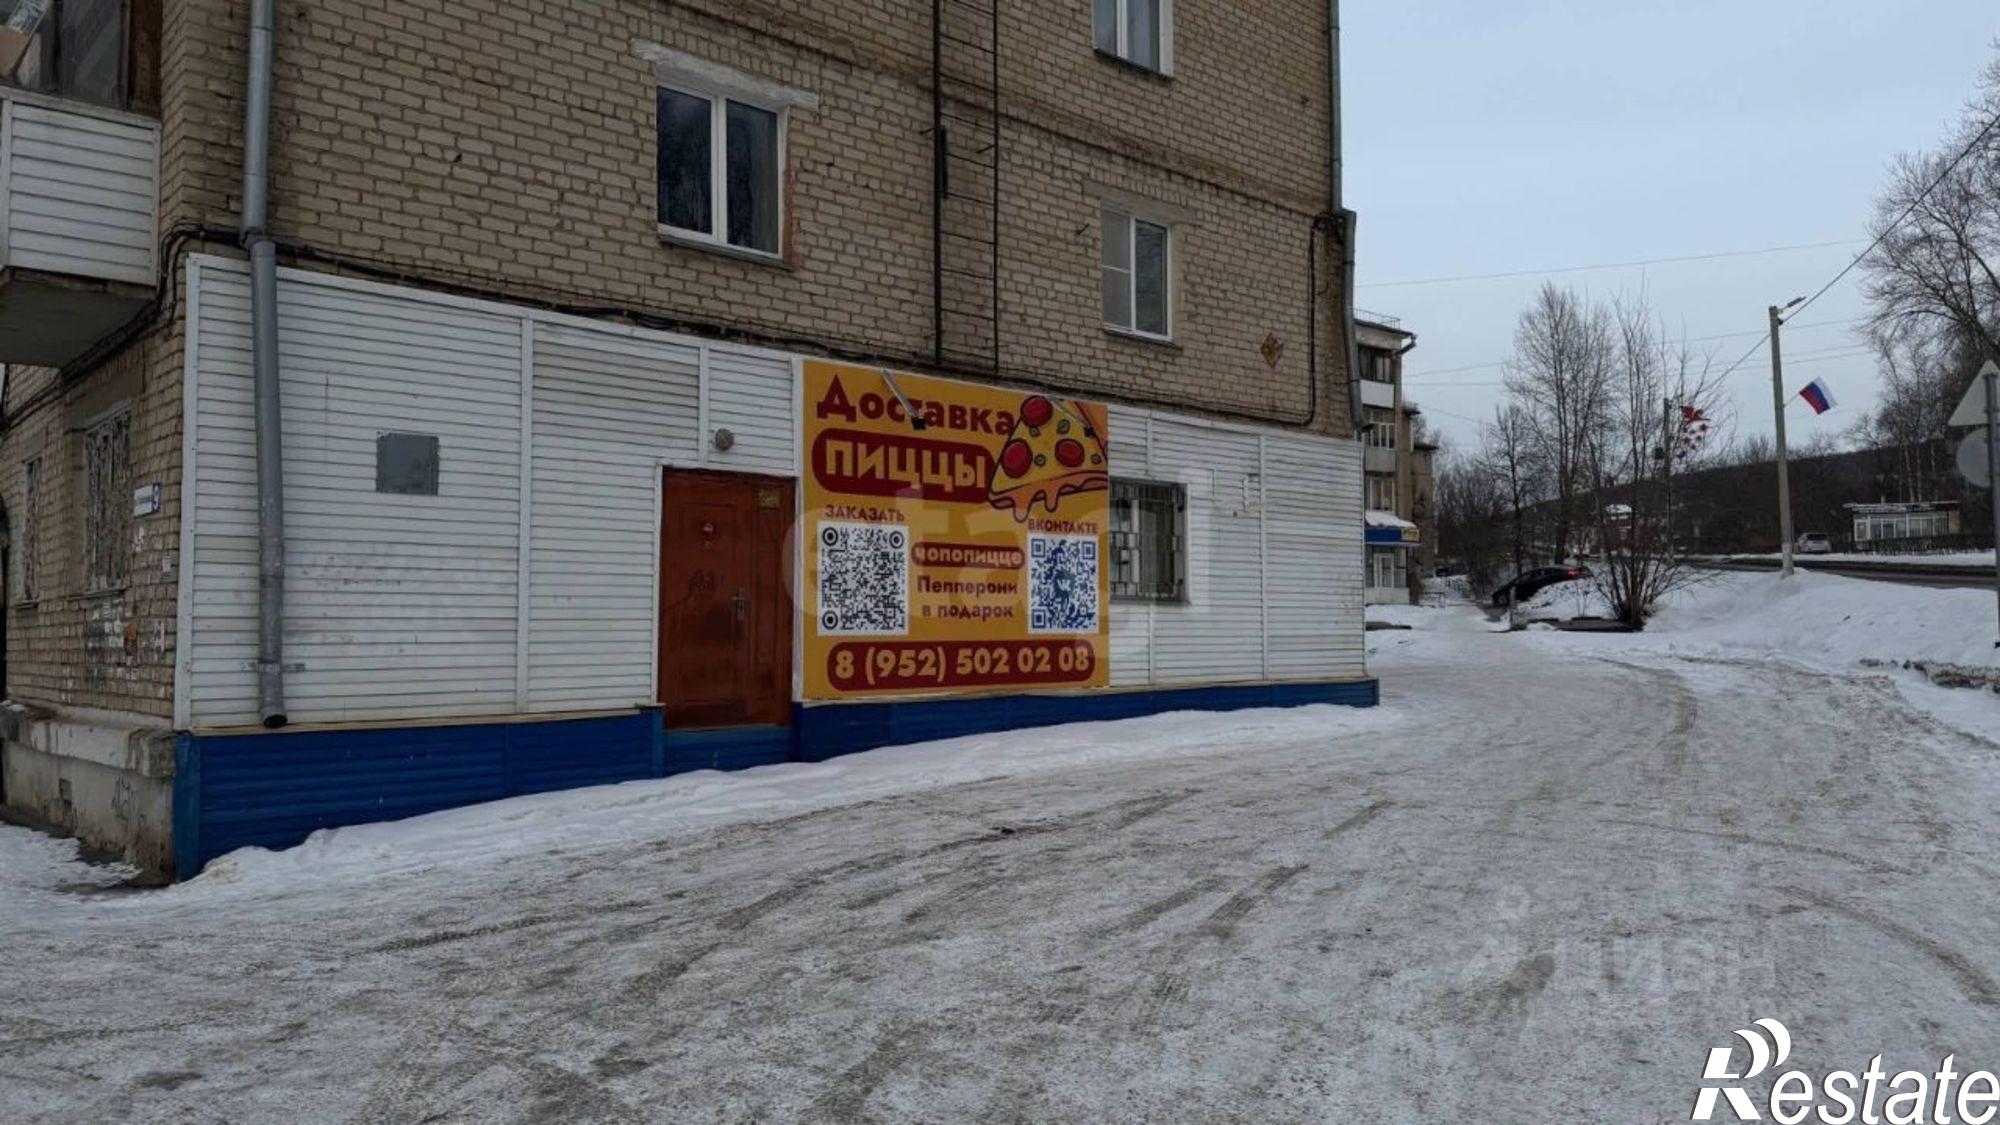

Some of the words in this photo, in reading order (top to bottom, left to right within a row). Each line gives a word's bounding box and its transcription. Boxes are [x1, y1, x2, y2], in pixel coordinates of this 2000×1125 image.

[825, 504, 906, 521] ЗАКАЗАТЬ
[1028, 519, 1098, 534] ВКОНТАКТЕ
[917, 575, 1018, 598] Пепперони
[922, 604, 932, 617] в
[937, 604, 1014, 622] подарок
[835, 650, 855, 679] 8
[865, 647, 946, 685] (952)
[956, 648, 1010, 675] 502
[1017, 647, 1051, 673] 02
[1058, 647, 1090, 672] 08
